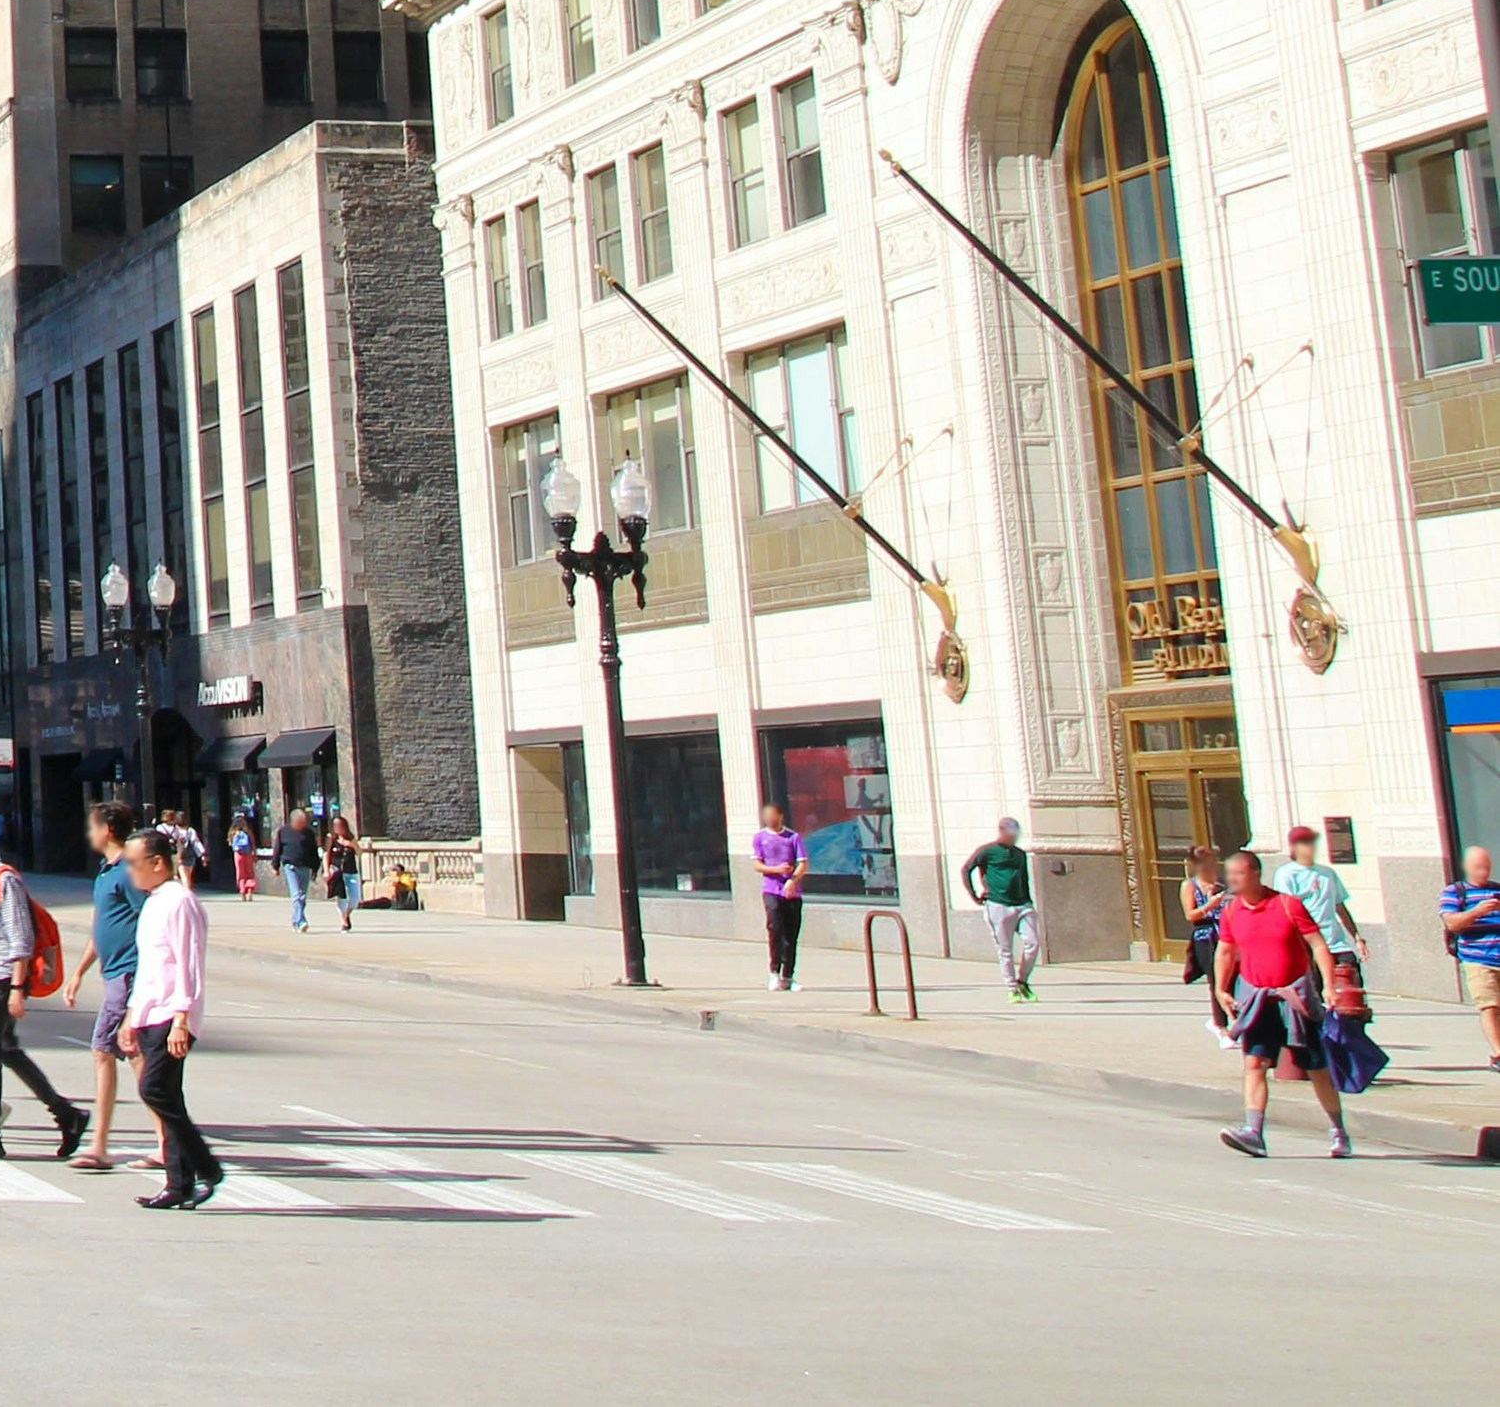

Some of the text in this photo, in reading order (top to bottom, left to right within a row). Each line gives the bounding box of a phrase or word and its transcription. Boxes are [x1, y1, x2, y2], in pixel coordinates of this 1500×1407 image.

[1431, 266, 1500, 292] E SOU
[1126, 600, 1172, 635] Old
